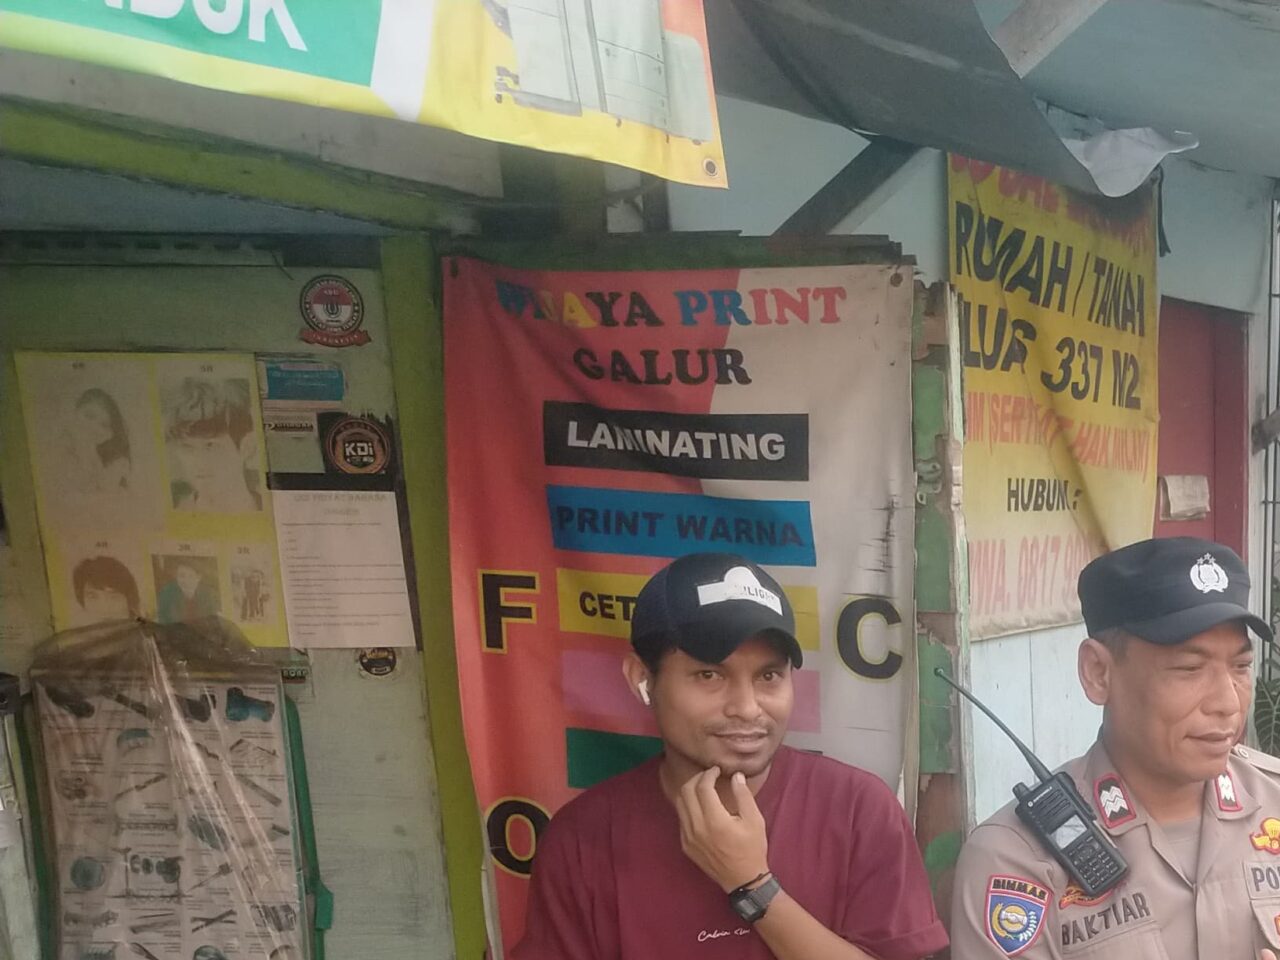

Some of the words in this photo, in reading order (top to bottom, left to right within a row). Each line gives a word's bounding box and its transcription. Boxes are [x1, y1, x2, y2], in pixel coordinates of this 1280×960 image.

[673, 286, 847, 326] PRINT
[572, 348, 753, 386] GALUR
[1040, 336, 1104, 403] 337
[566, 420, 786, 462] LAMINATING
[556, 505, 665, 538] PRINT
[675, 514, 805, 548] WARNA
[578, 590, 635, 620] CET
[1061, 891, 1152, 946] BAKTIAR
